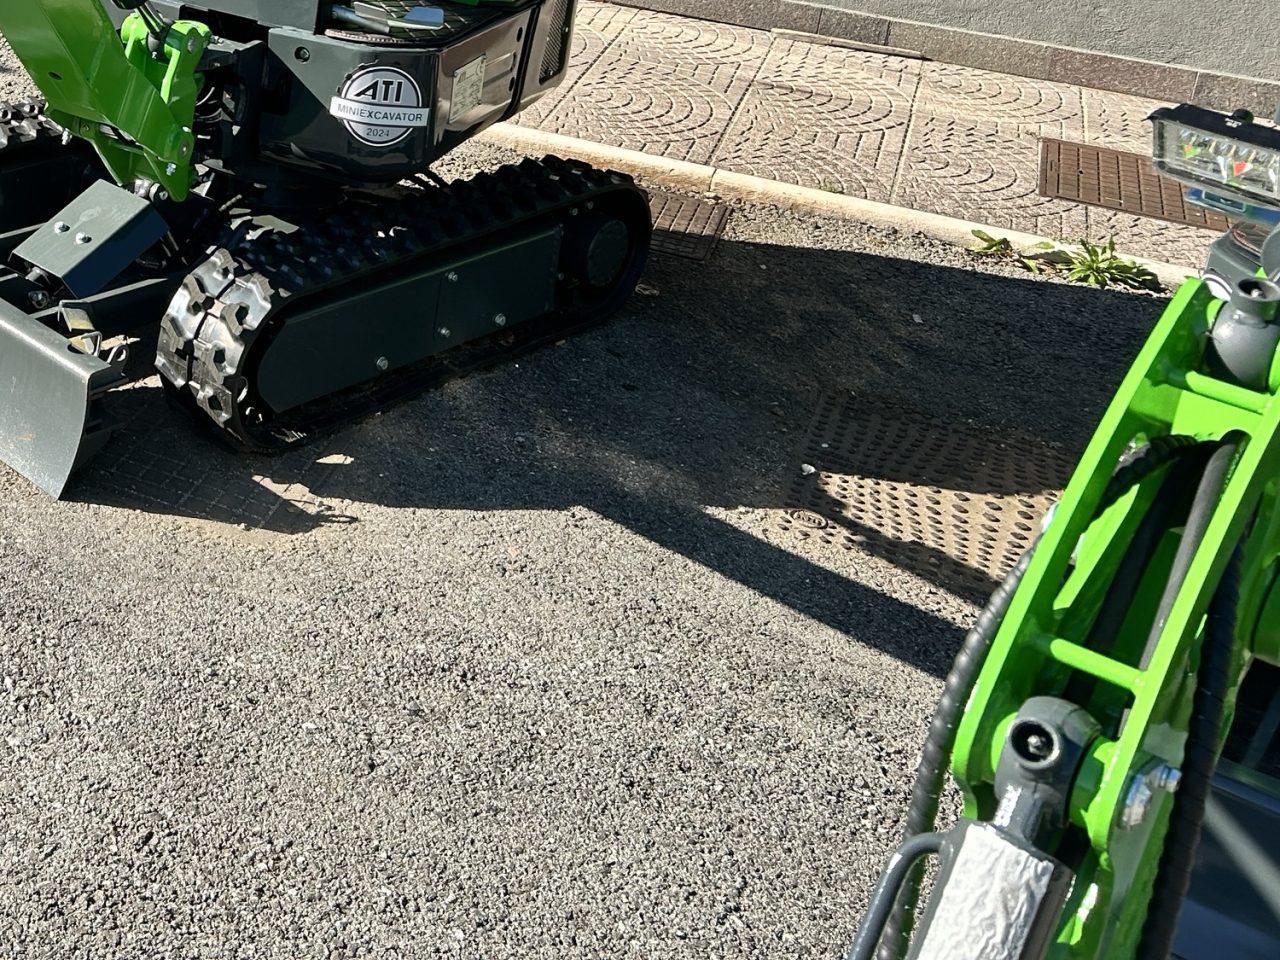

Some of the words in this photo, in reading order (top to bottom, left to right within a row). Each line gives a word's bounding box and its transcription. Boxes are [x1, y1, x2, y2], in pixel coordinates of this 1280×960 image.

[353, 79, 404, 103] ATI
[337, 103, 423, 122] MINIEXCAVATOR
[365, 127, 391, 138] 2024
